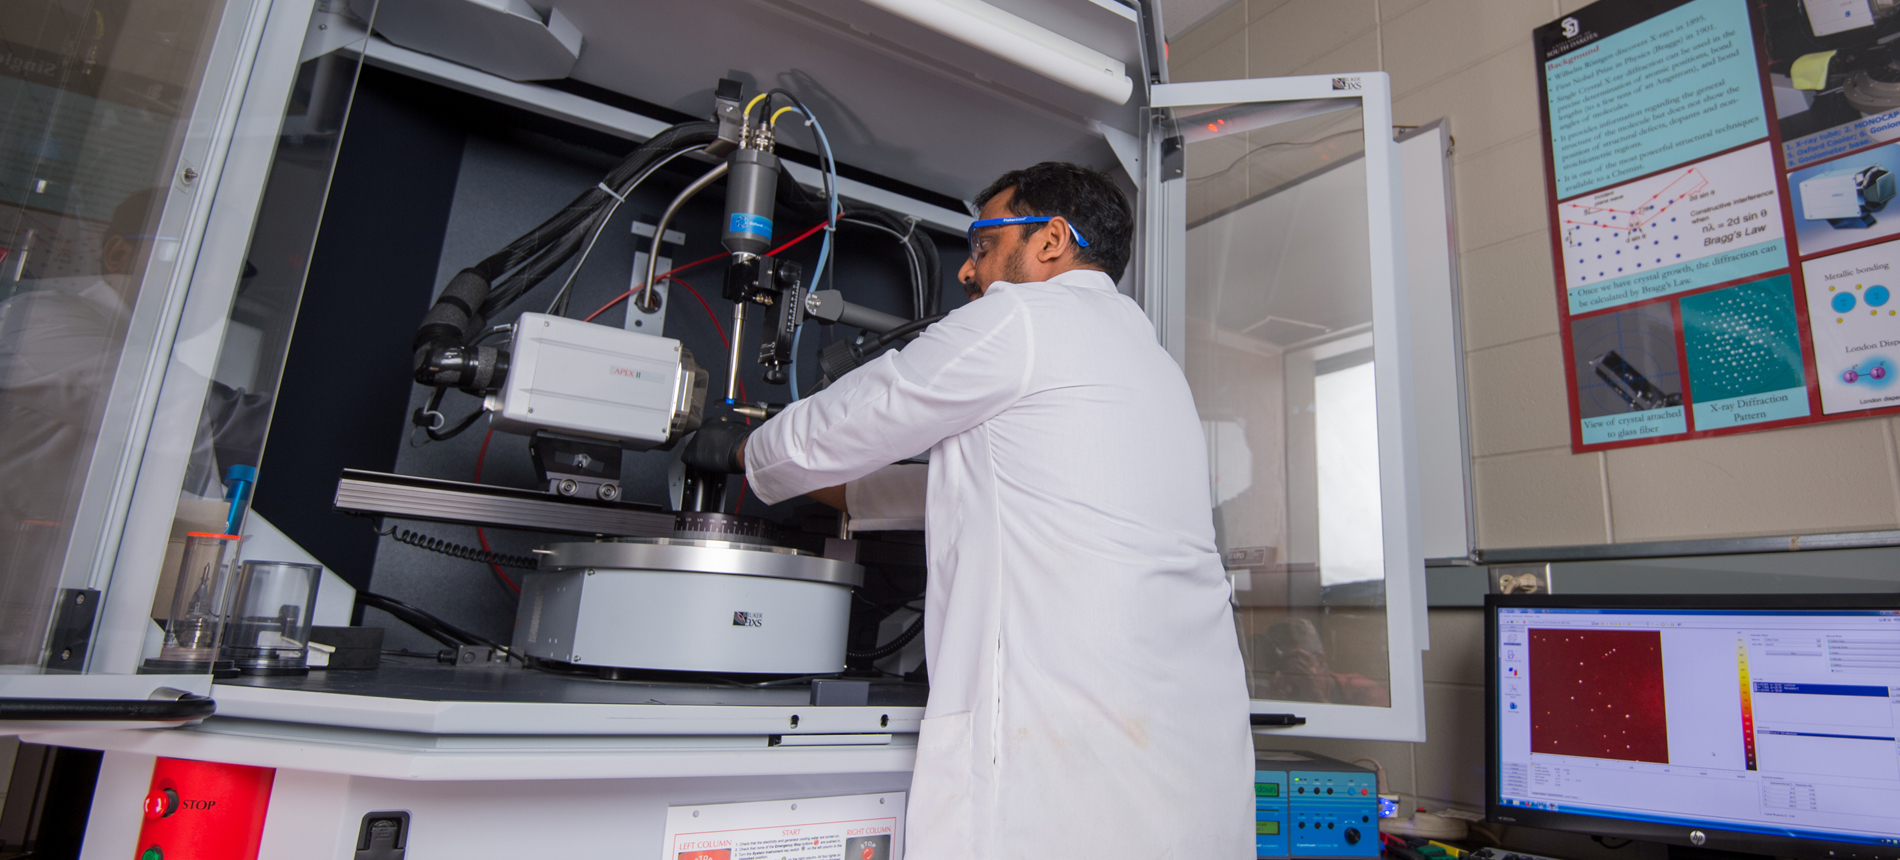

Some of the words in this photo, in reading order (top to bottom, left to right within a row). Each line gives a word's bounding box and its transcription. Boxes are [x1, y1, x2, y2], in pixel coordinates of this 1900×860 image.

[1546, 44, 1569, 58] SOUTH
[1570, 32, 1598, 48] DAKOTA
[1554, 65, 1582, 79] Wilhelm
[1614, 39, 1648, 56] discovers
[1649, 28, 1674, 42] X-rays
[1547, 45, 1599, 70] Background
[1555, 81, 1571, 91] First
[1572, 71, 1594, 84] Nobel
[1595, 65, 1613, 76] Prize
[1623, 50, 1651, 64] Physics
[1652, 36, 1683, 54] (Braggs)
[1556, 91, 1576, 102] Single
[1577, 80, 1602, 94] Crystal
[1604, 73, 1623, 84] X-ray
[1625, 57, 1664, 76] diffraction
[1665, 51, 1679, 61] can
[1692, 37, 1711, 50] used
[1722, 29, 1735, 38] the
[1557, 99, 1581, 113] precise
[1582, 80, 1632, 102] determination
[1644, 65, 1669, 79] atomic
[1710, 40, 1732, 54] bond
[1557, 108, 1582, 121] lengths
[1601, 96, 1614, 105] few
[1616, 90, 1632, 100] tens
[1700, 57, 1716, 68] and
[1717, 48, 1739, 62] bond
[1561, 137, 1592, 151] structure
[1617, 116, 1650, 132] molecule
[1651, 111, 1665, 120] but
[1666, 105, 1685, 115] does
[1687, 99, 1701, 108] not
[1702, 91, 1724, 102] show
[1726, 85, 1739, 94] the
[1567, 125, 1597, 141] provides
[1599, 109, 1642, 128] information
[1644, 96, 1680, 113] regarding
[1681, 91, 1694, 99] the
[1696, 77, 1725, 96] general
[1559, 119, 1580, 130] angles
[1561, 147, 1590, 163] position
[1602, 130, 1637, 147] structural
[1668, 110, 1700, 125] dopants
[1702, 102, 1718, 114] and
[1578, 169, 1592, 177] one
[1605, 161, 1617, 169] the
[1618, 154, 1637, 165] most
[1638, 142, 1673, 161] powerful
[1674, 128, 1713, 147] structural
[1714, 115, 1759, 134] techniques
[1795, 137, 1817, 147] X-ray
[1819, 129, 1841, 140] tube;
[1843, 125, 1852, 133] 2.
[1796, 142, 1825, 155] Oxford
[1826, 134, 1856, 146] Cooler;
[1798, 145, 1846, 163] Goniometer
[1848, 138, 1871, 149] base.
[1564, 178, 1594, 192] available
[1690, 201, 1732, 216] Constructive
[1732, 189, 1774, 204] interference
[1691, 215, 1709, 224] when
[1726, 215, 1740, 226] 2d
[1742, 212, 1758, 222] sin
[1703, 230, 1742, 246] Bragg's
[1744, 224, 1766, 236] Law
[1577, 287, 1598, 296] Once
[1612, 279, 1631, 288] have
[1633, 270, 1659, 284] crystal
[1661, 264, 1694, 280] growth,
[1695, 261, 1709, 269] the
[1711, 249, 1758, 265] diffraction
[1760, 244, 1777, 254] can
[1824, 269, 1854, 281] Metallic
[1855, 262, 1889, 274] bonding
[1589, 289, 1628, 305] calculated
[1629, 288, 1639, 296] by
[1641, 280, 1671, 294] Bragg's
[1845, 343, 1877, 352] London
[614, 368, 634, 377] APEX
[1710, 403, 1734, 412] X-ray
[1736, 394, 1788, 408] Diffraction
[1605, 417, 1615, 426] of
[1617, 413, 1644, 424] crystal
[1646, 408, 1681, 421] attached
[1733, 411, 1766, 421] Pattern
[1617, 428, 1637, 438] glass
[1639, 425, 1658, 434] fiber
[182, 799, 216, 810] STOP
[866, 826, 891, 834] COLUMN
[1691, 830, 1704, 845] hp
[680, 842, 695, 850] LEFT
[697, 840, 732, 848] COLUMN
[860, 841, 876, 849] STOP
